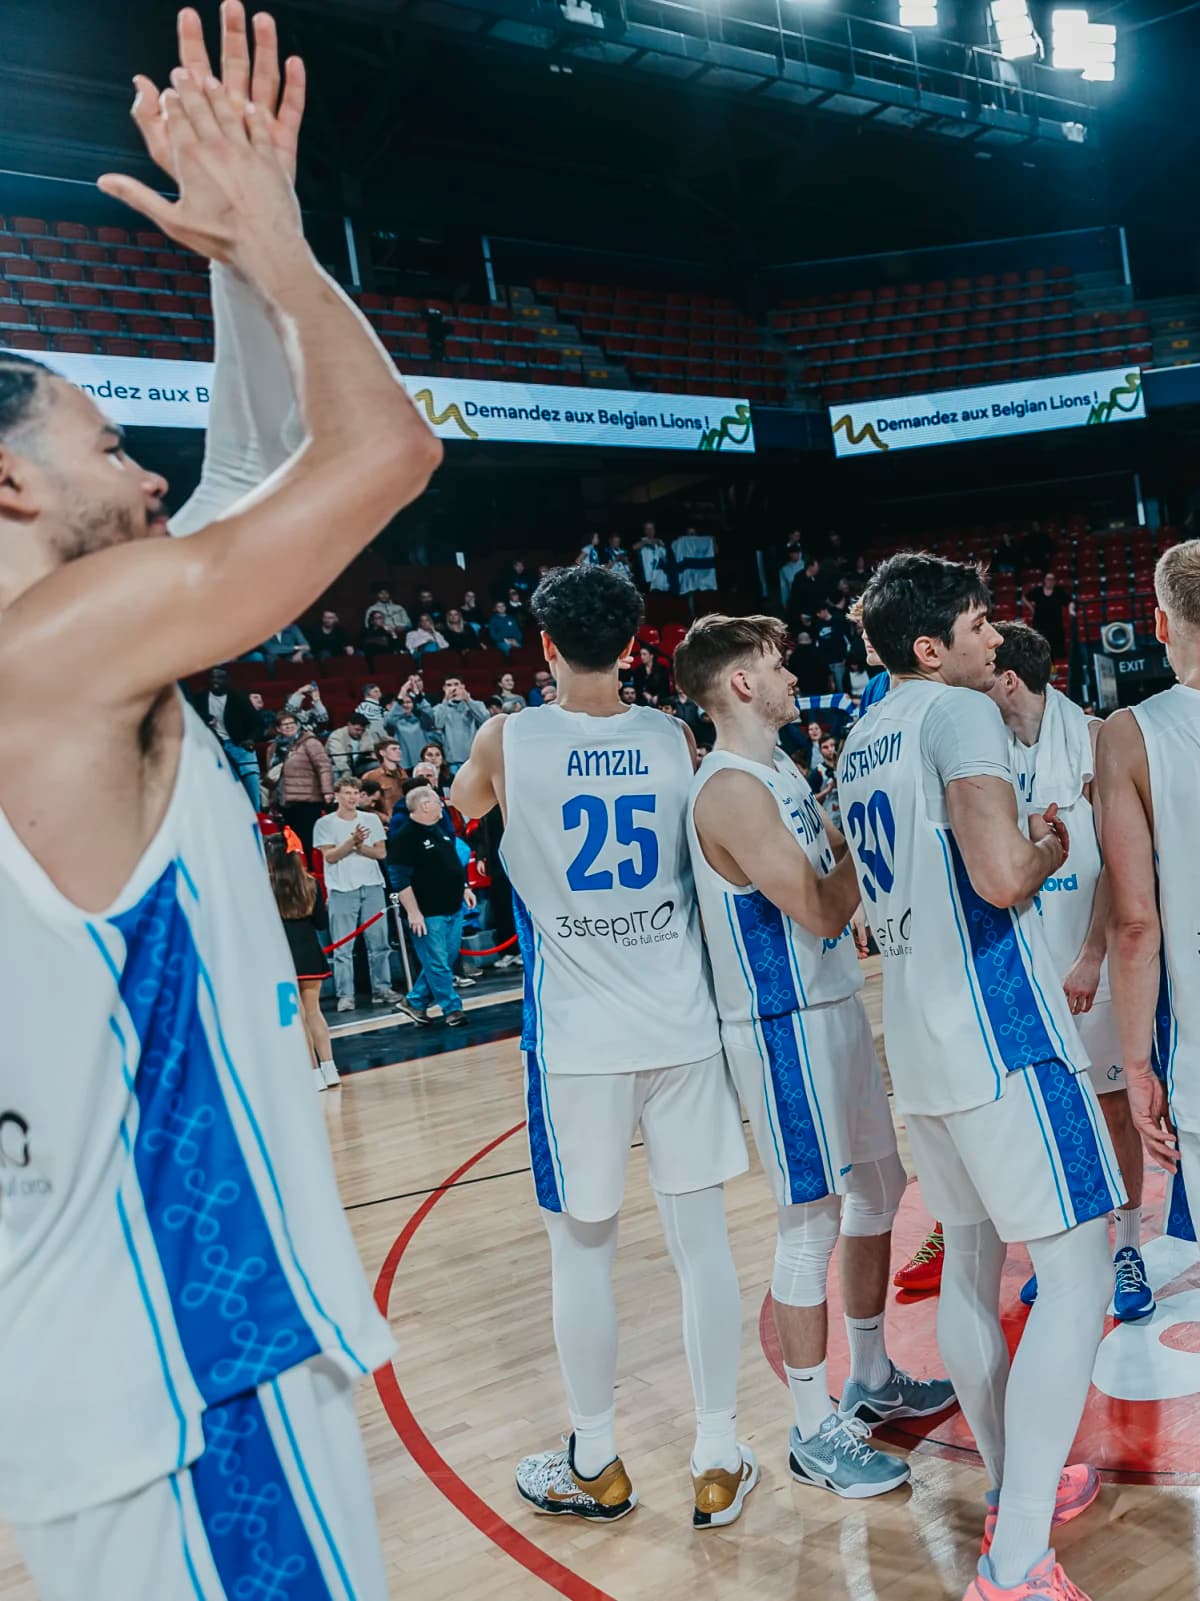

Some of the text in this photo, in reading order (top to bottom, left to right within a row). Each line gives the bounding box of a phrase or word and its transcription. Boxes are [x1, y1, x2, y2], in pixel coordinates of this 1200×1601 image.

[80, 380, 142, 400] ndez
[148, 387, 191, 402] aux
[465, 401, 710, 430] Demandez aux Belgian Lions !
[876, 407, 958, 432] Demandez
[961, 407, 989, 422] aux
[992, 398, 1047, 419] Belgian
[1050, 394, 1091, 411] Lions
[1119, 659, 1145, 673] EXIT
[567, 749, 649, 777] AMZIL
[562, 794, 659, 892] 25
[622, 930, 679, 947] Go full circle
